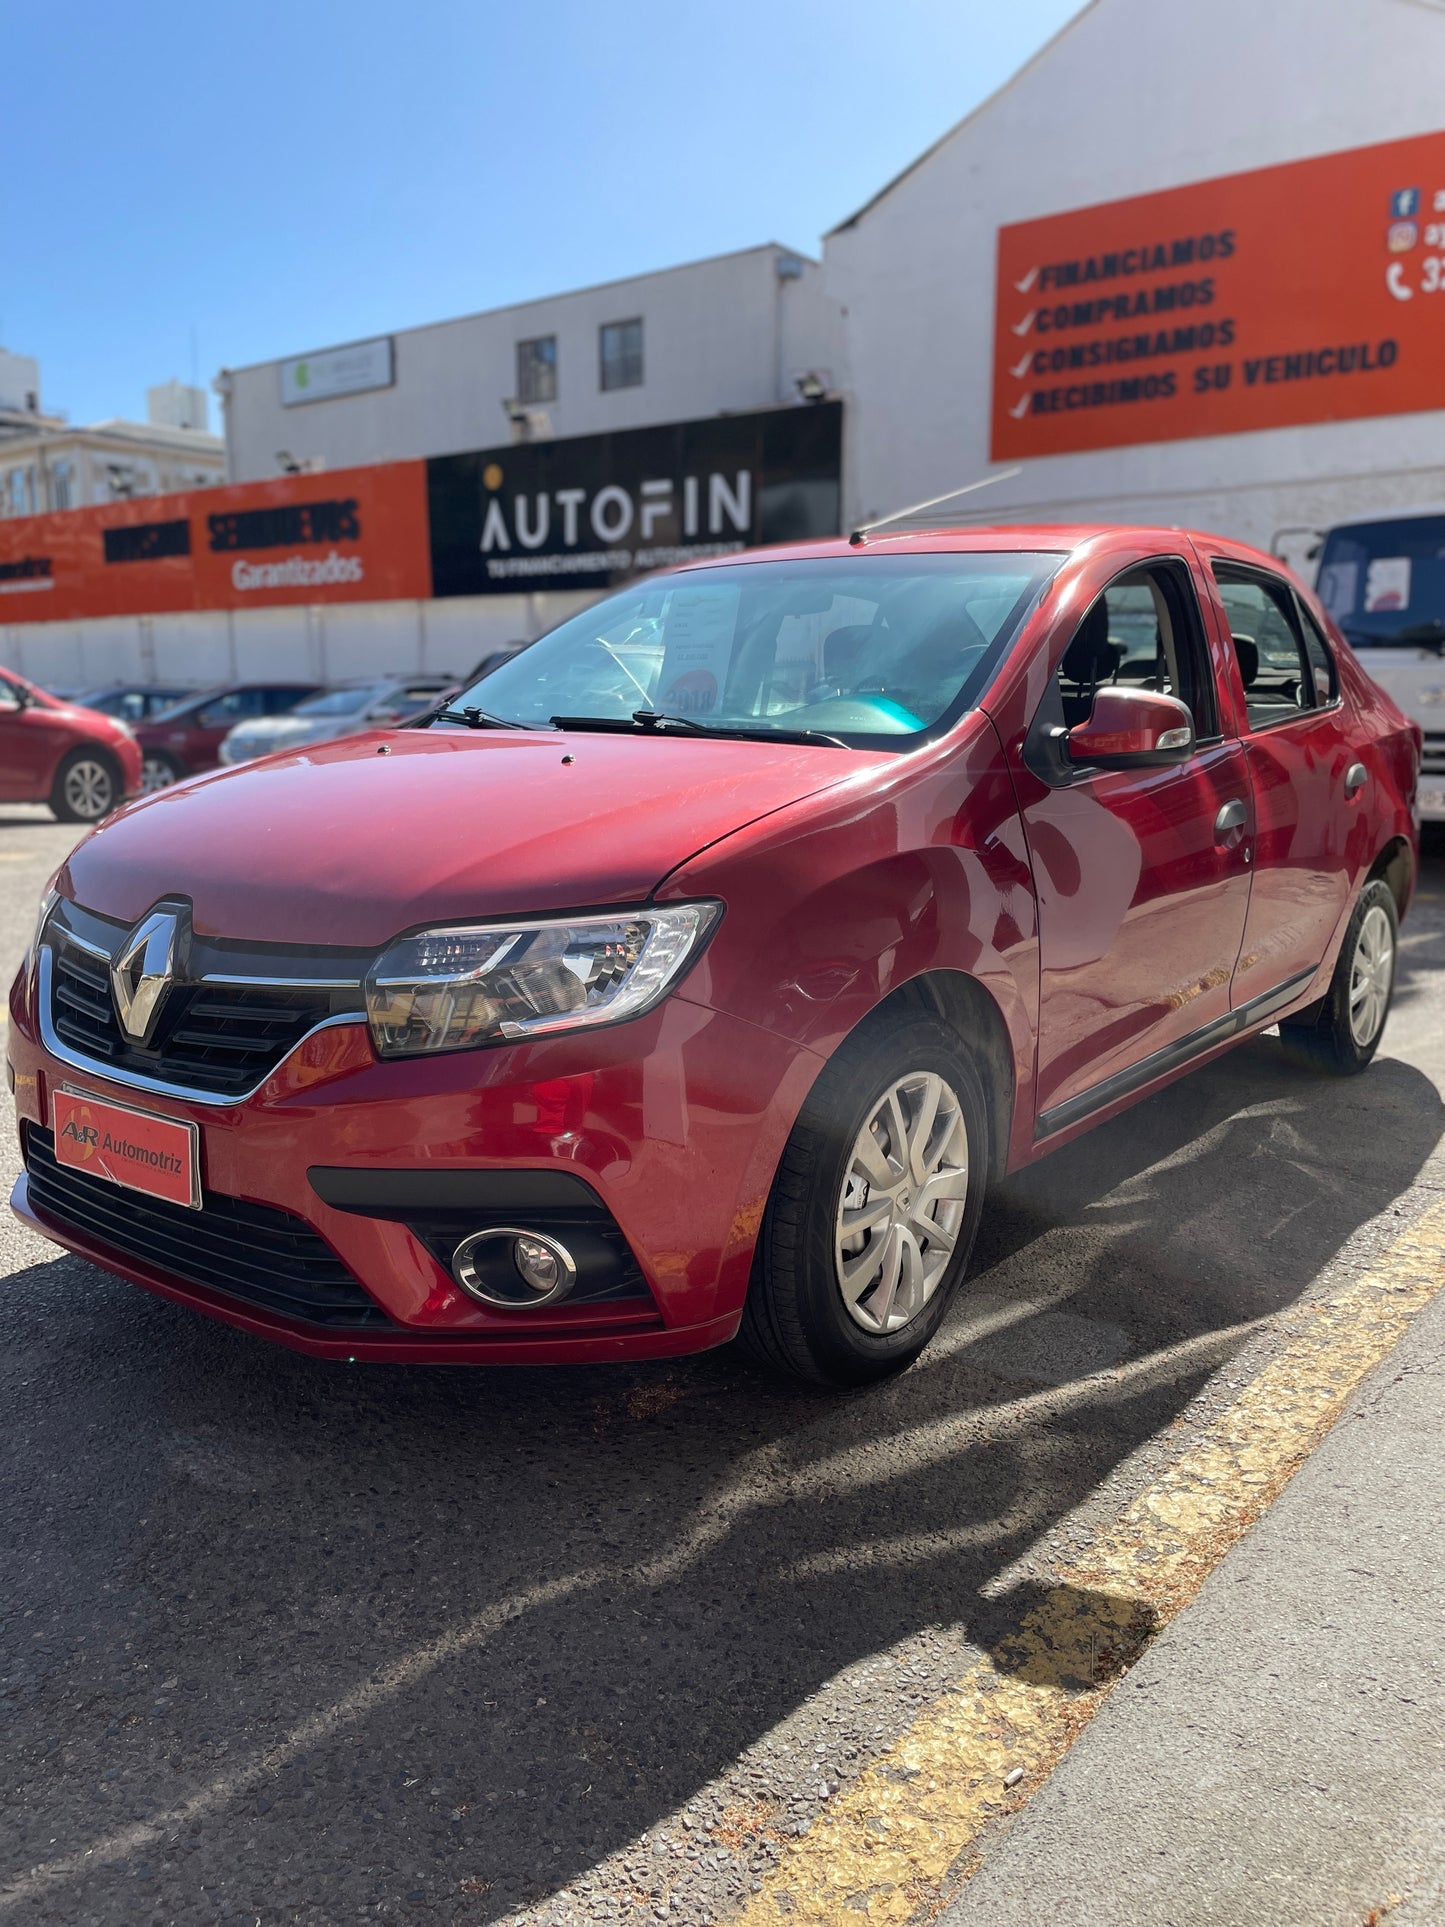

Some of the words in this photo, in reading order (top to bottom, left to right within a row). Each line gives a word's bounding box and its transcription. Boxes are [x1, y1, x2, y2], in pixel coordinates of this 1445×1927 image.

[1038, 230, 1237, 291] FINANCIAMOS
[1034, 278, 1216, 333] COMPRAMOS
[1032, 319, 1236, 374] CONSIGNAMOS
[1031, 372, 1177, 415] RECIBIMOS
[1193, 364, 1232, 393] SU
[1244, 339, 1397, 387] VEHICULO
[480, 470, 752, 552] AUTOFIN
[232, 551, 363, 591] Garantizados
[61, 1122, 99, 1147] A&R
[102, 1133, 183, 1175] Automotriz
